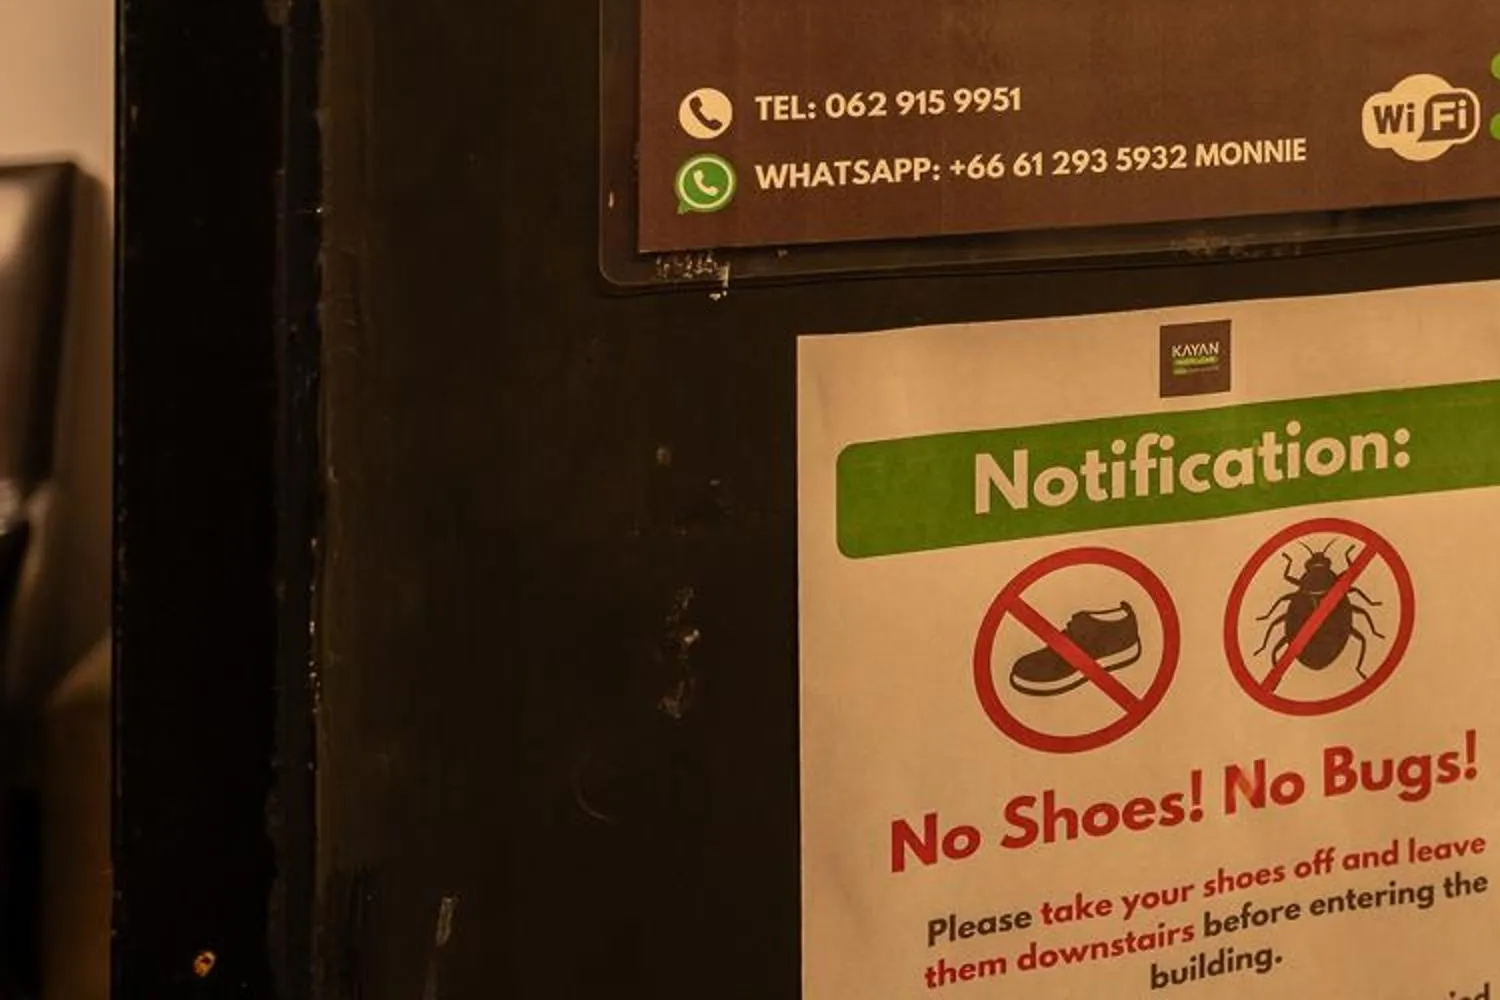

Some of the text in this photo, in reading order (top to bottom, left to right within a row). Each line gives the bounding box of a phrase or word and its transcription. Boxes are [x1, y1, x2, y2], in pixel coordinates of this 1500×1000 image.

[755, 87, 1020, 120] TEL: 062 915 9951
[755, 138, 1306, 189] WHATSAPP: +66 61 293 5932 MONNIE
[1171, 341, 1219, 357] KAYAN
[976, 421, 1410, 514] Notification:
[892, 729, 1477, 872] No Shoes! No Bugs!
[928, 837, 1485, 947] Please take your shoes off and leave
[924, 871, 1488, 989] them downstairs before entering the
[1151, 948, 1282, 990] building.
